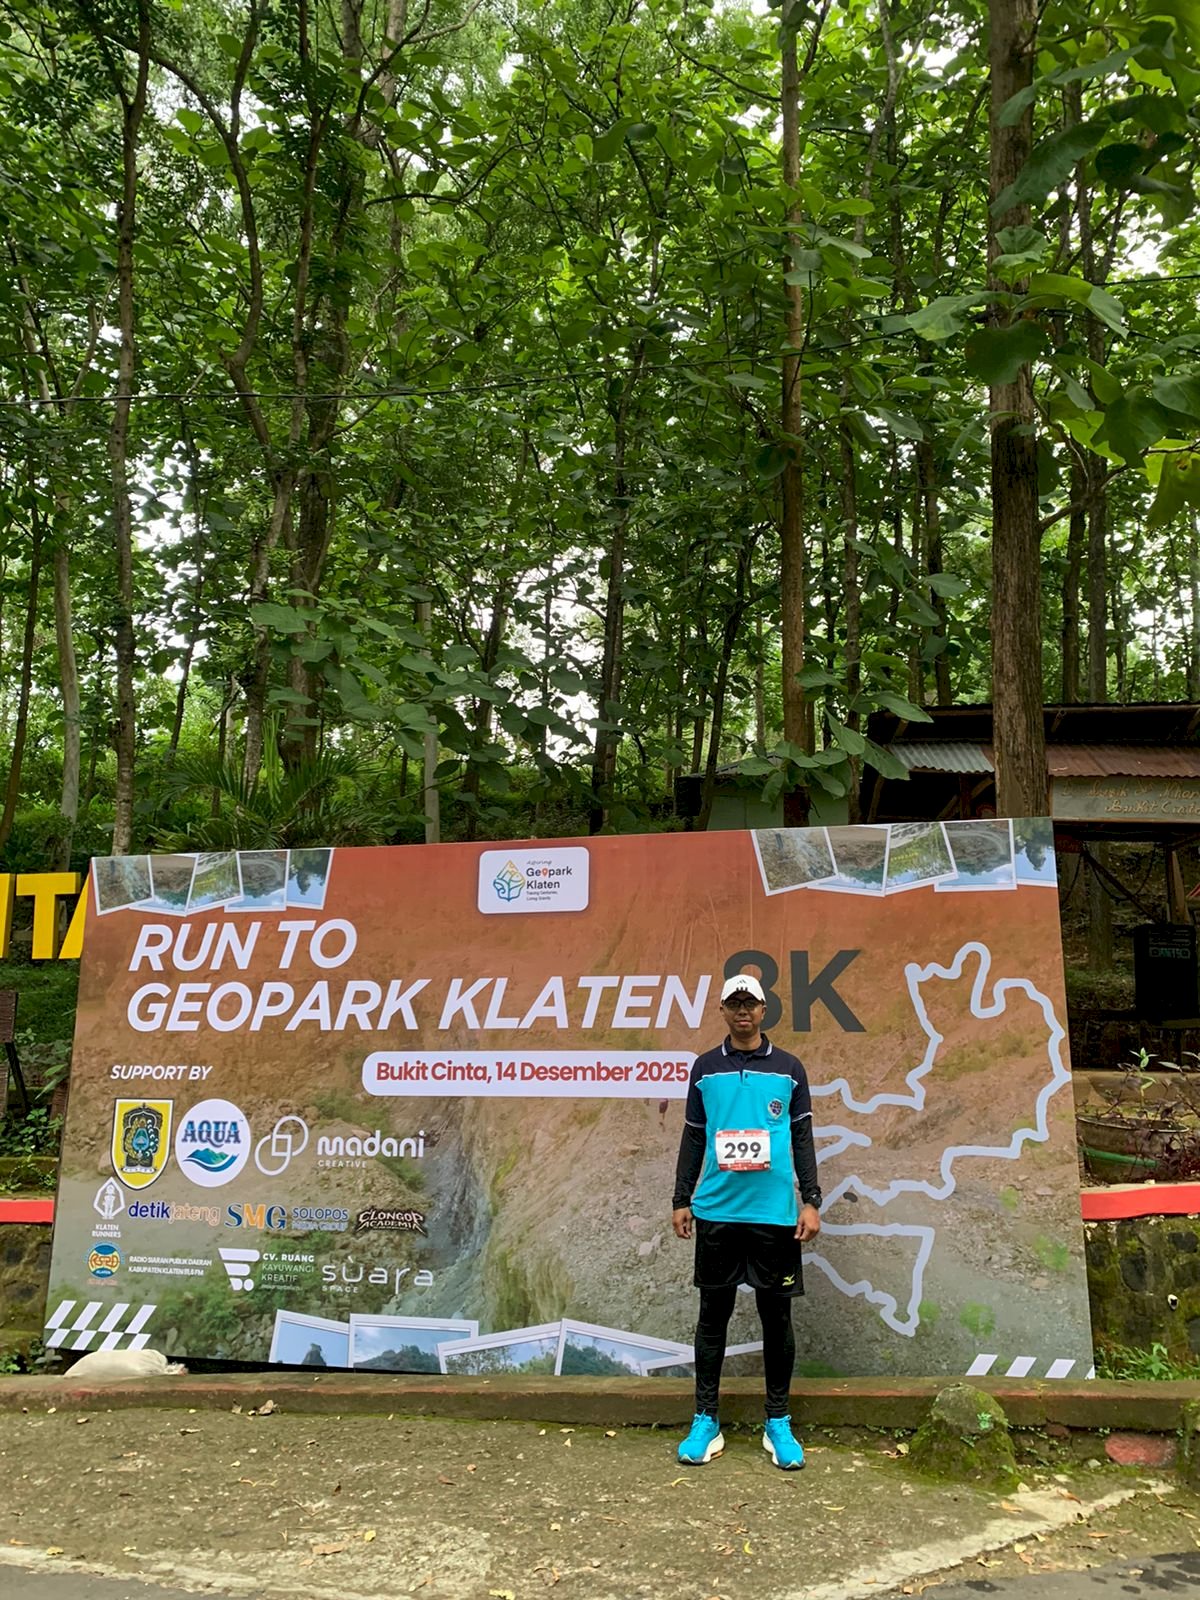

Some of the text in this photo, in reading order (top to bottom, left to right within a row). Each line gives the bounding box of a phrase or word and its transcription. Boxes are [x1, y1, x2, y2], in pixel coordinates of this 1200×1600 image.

[526, 880, 560, 890] Klaten
[128, 918, 358, 972] RUN TO
[127, 949, 867, 1033] GEOPARK KLATEN 8K
[110, 1065, 212, 1081] SUPPORT BY
[376, 1060, 689, 1085] Bukit Cinta, 14 Desember 2025
[181, 1120, 241, 1148] AQUA
[317, 1130, 426, 1158] madani
[724, 1141, 762, 1159] 299
[318, 1159, 367, 1168] CREATIVE
[128, 1201, 221, 1227] detikjateng
[224, 1203, 287, 1230] SMG
[293, 1207, 349, 1220] SOLOPOS
[262, 1253, 315, 1262] CV. RUANG
[261, 1273, 298, 1283] KREATIF
[322, 1285, 359, 1294] SPACE
